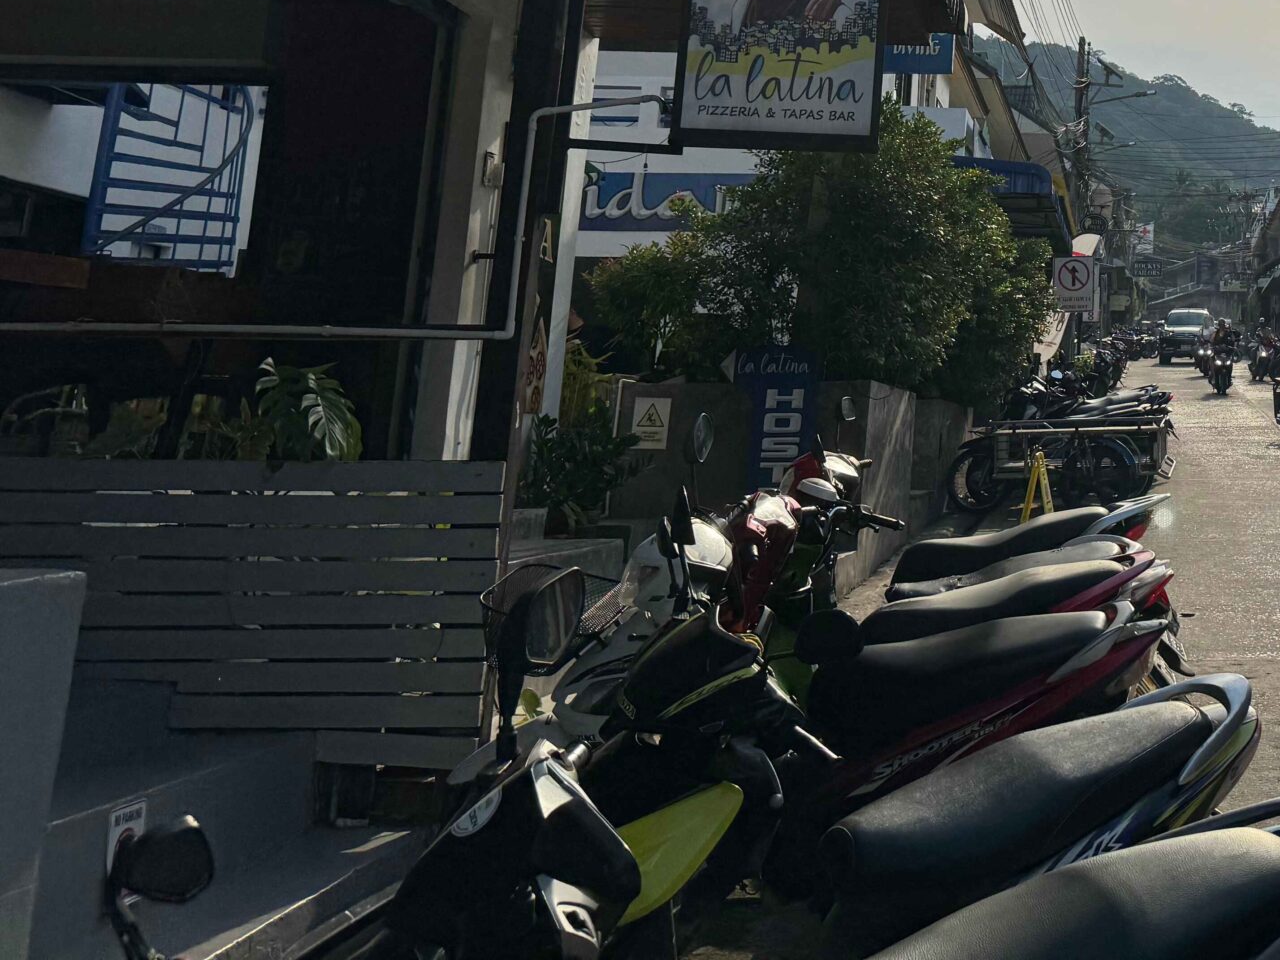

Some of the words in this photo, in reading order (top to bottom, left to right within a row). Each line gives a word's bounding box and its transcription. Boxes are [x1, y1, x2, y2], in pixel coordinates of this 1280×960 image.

[695, 51, 732, 101] la
[746, 52, 864, 105] latina
[698, 104, 760, 118] PIZZERIA
[766, 108, 776, 118] &
[782, 109, 823, 120] TAPAS
[829, 110, 856, 121] BAR
